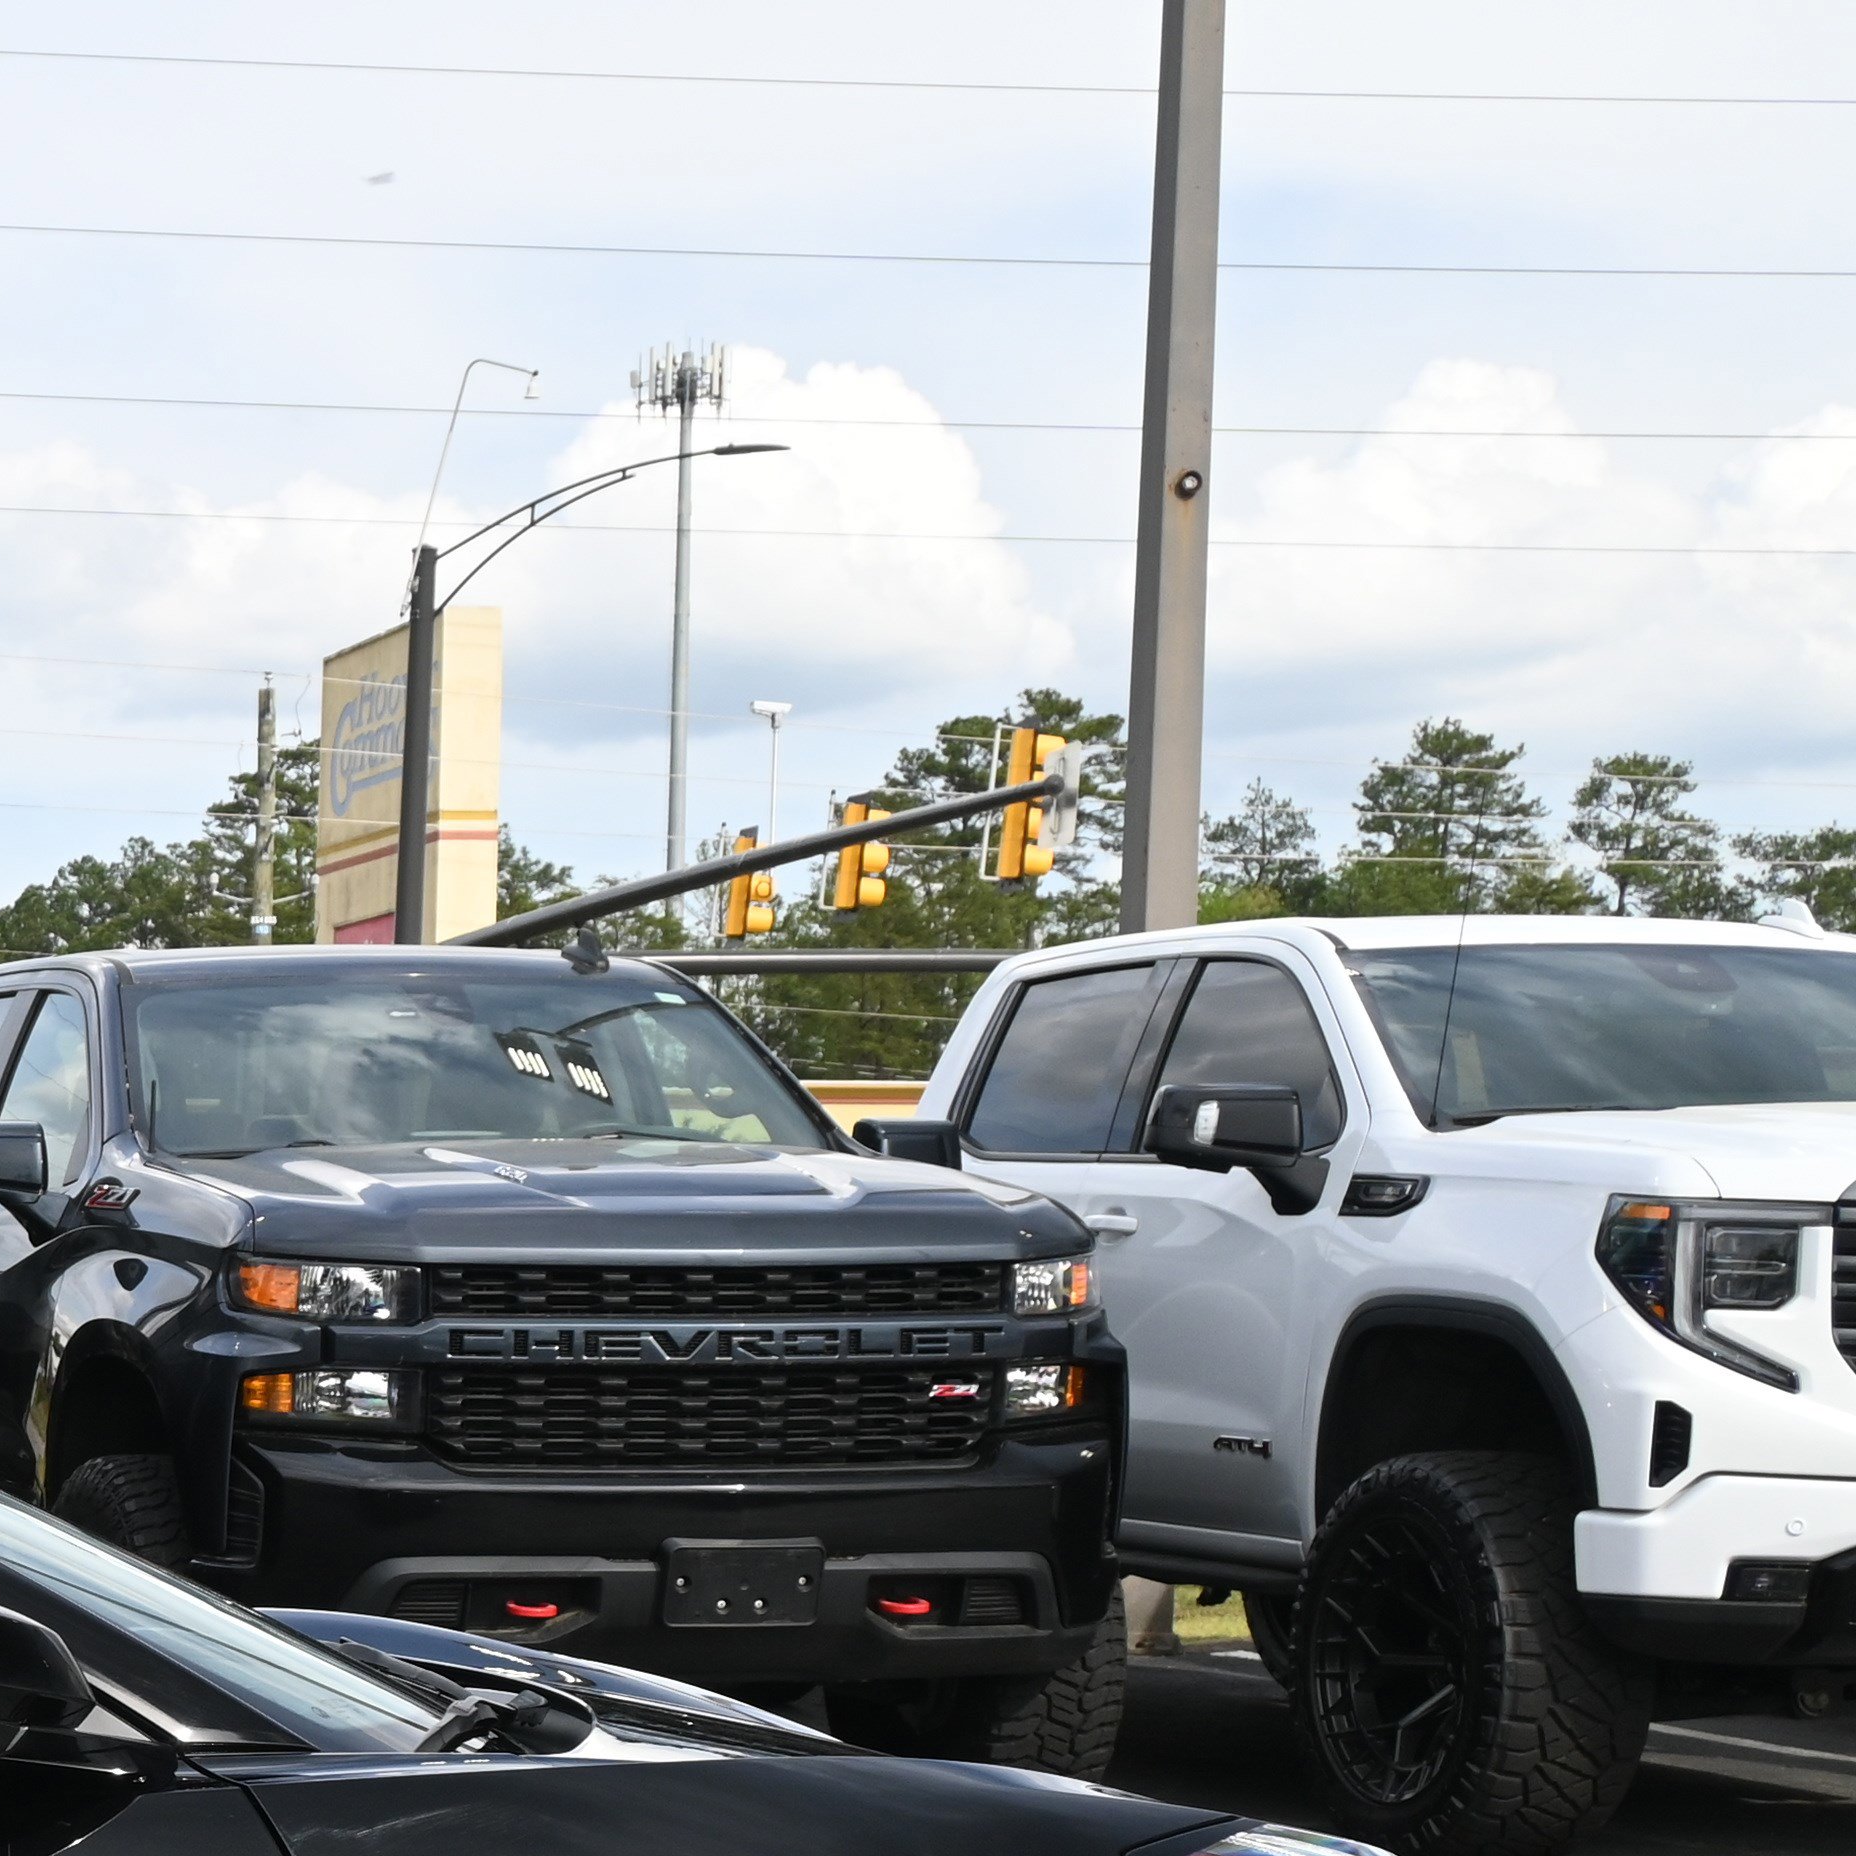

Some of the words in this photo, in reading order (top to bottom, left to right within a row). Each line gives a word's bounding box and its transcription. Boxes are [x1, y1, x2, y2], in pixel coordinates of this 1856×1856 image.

[85, 1185, 138, 1209] Z71
[448, 1327, 1006, 1360] CHEVROLET
[929, 1383, 980, 1398] Z71
[1213, 1434, 1273, 1460] AT4
